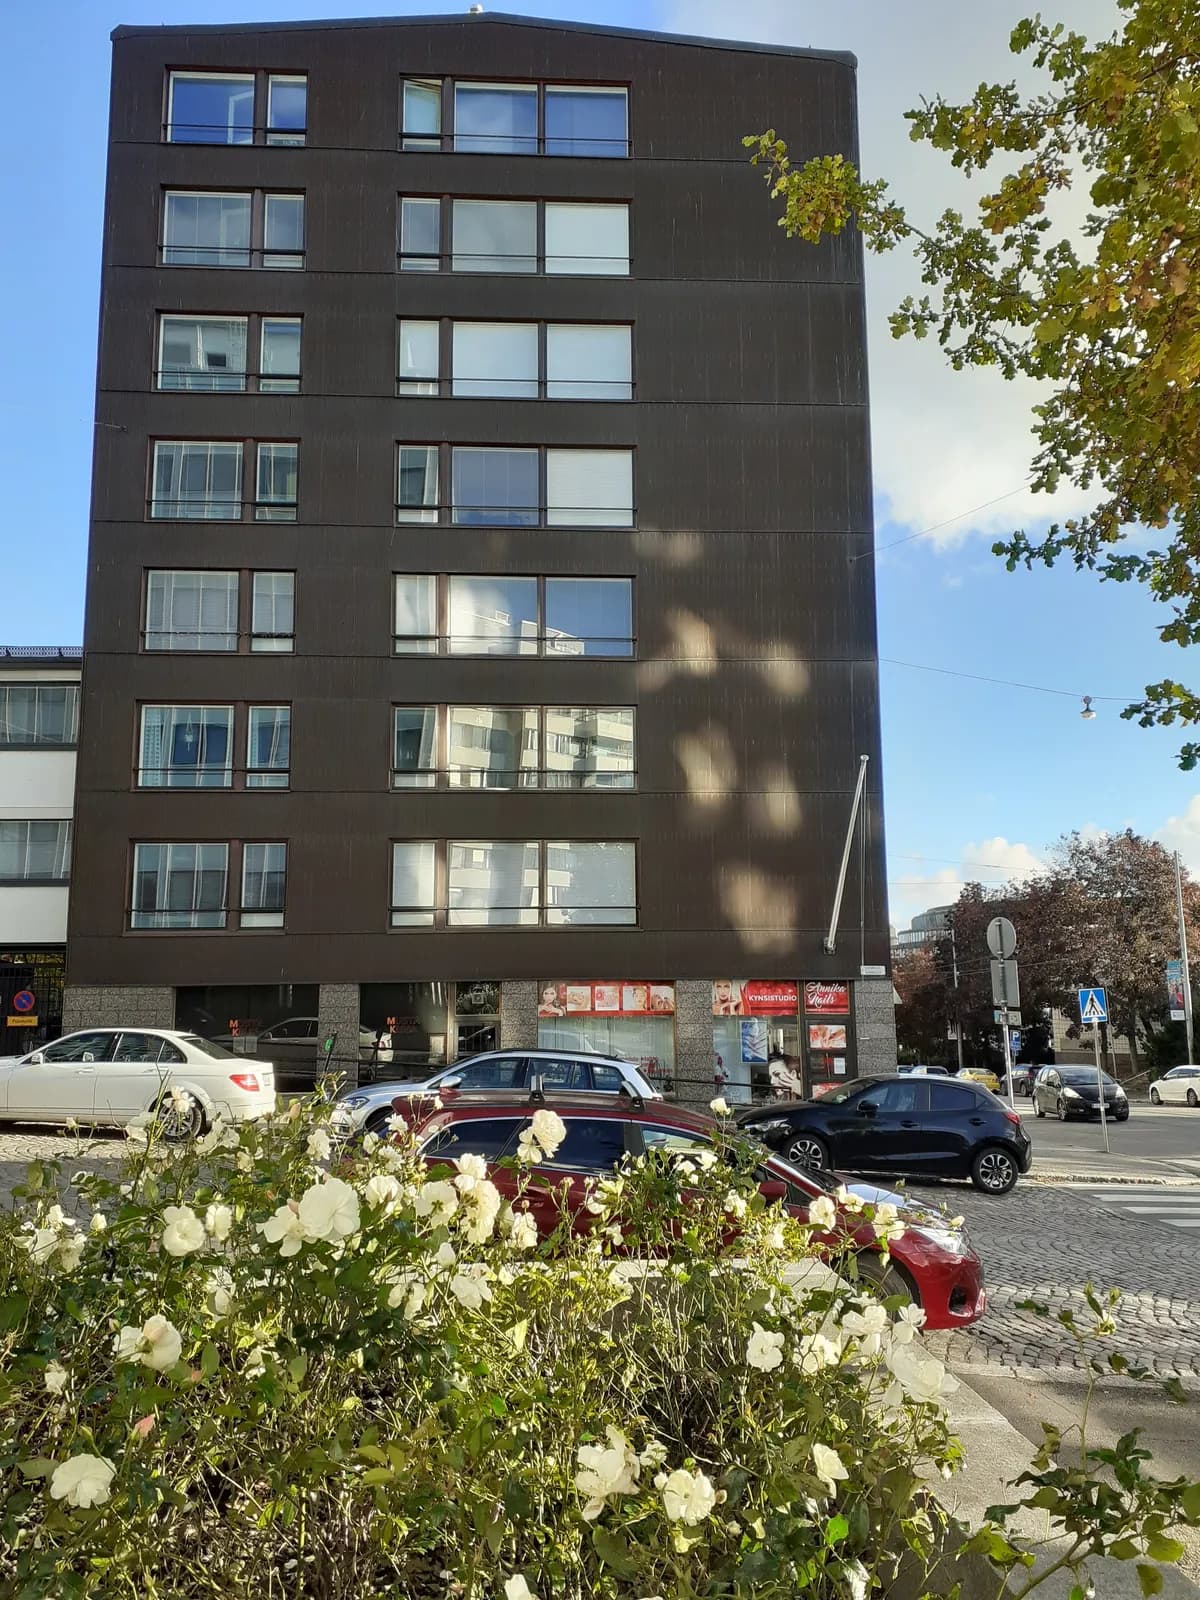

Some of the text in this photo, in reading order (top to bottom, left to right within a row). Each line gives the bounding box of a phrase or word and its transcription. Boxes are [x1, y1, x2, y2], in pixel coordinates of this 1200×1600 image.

[806, 982, 846, 994] Annika
[748, 994, 797, 1002] KYNSISTUDIO
[808, 992, 834, 1008] Nails
